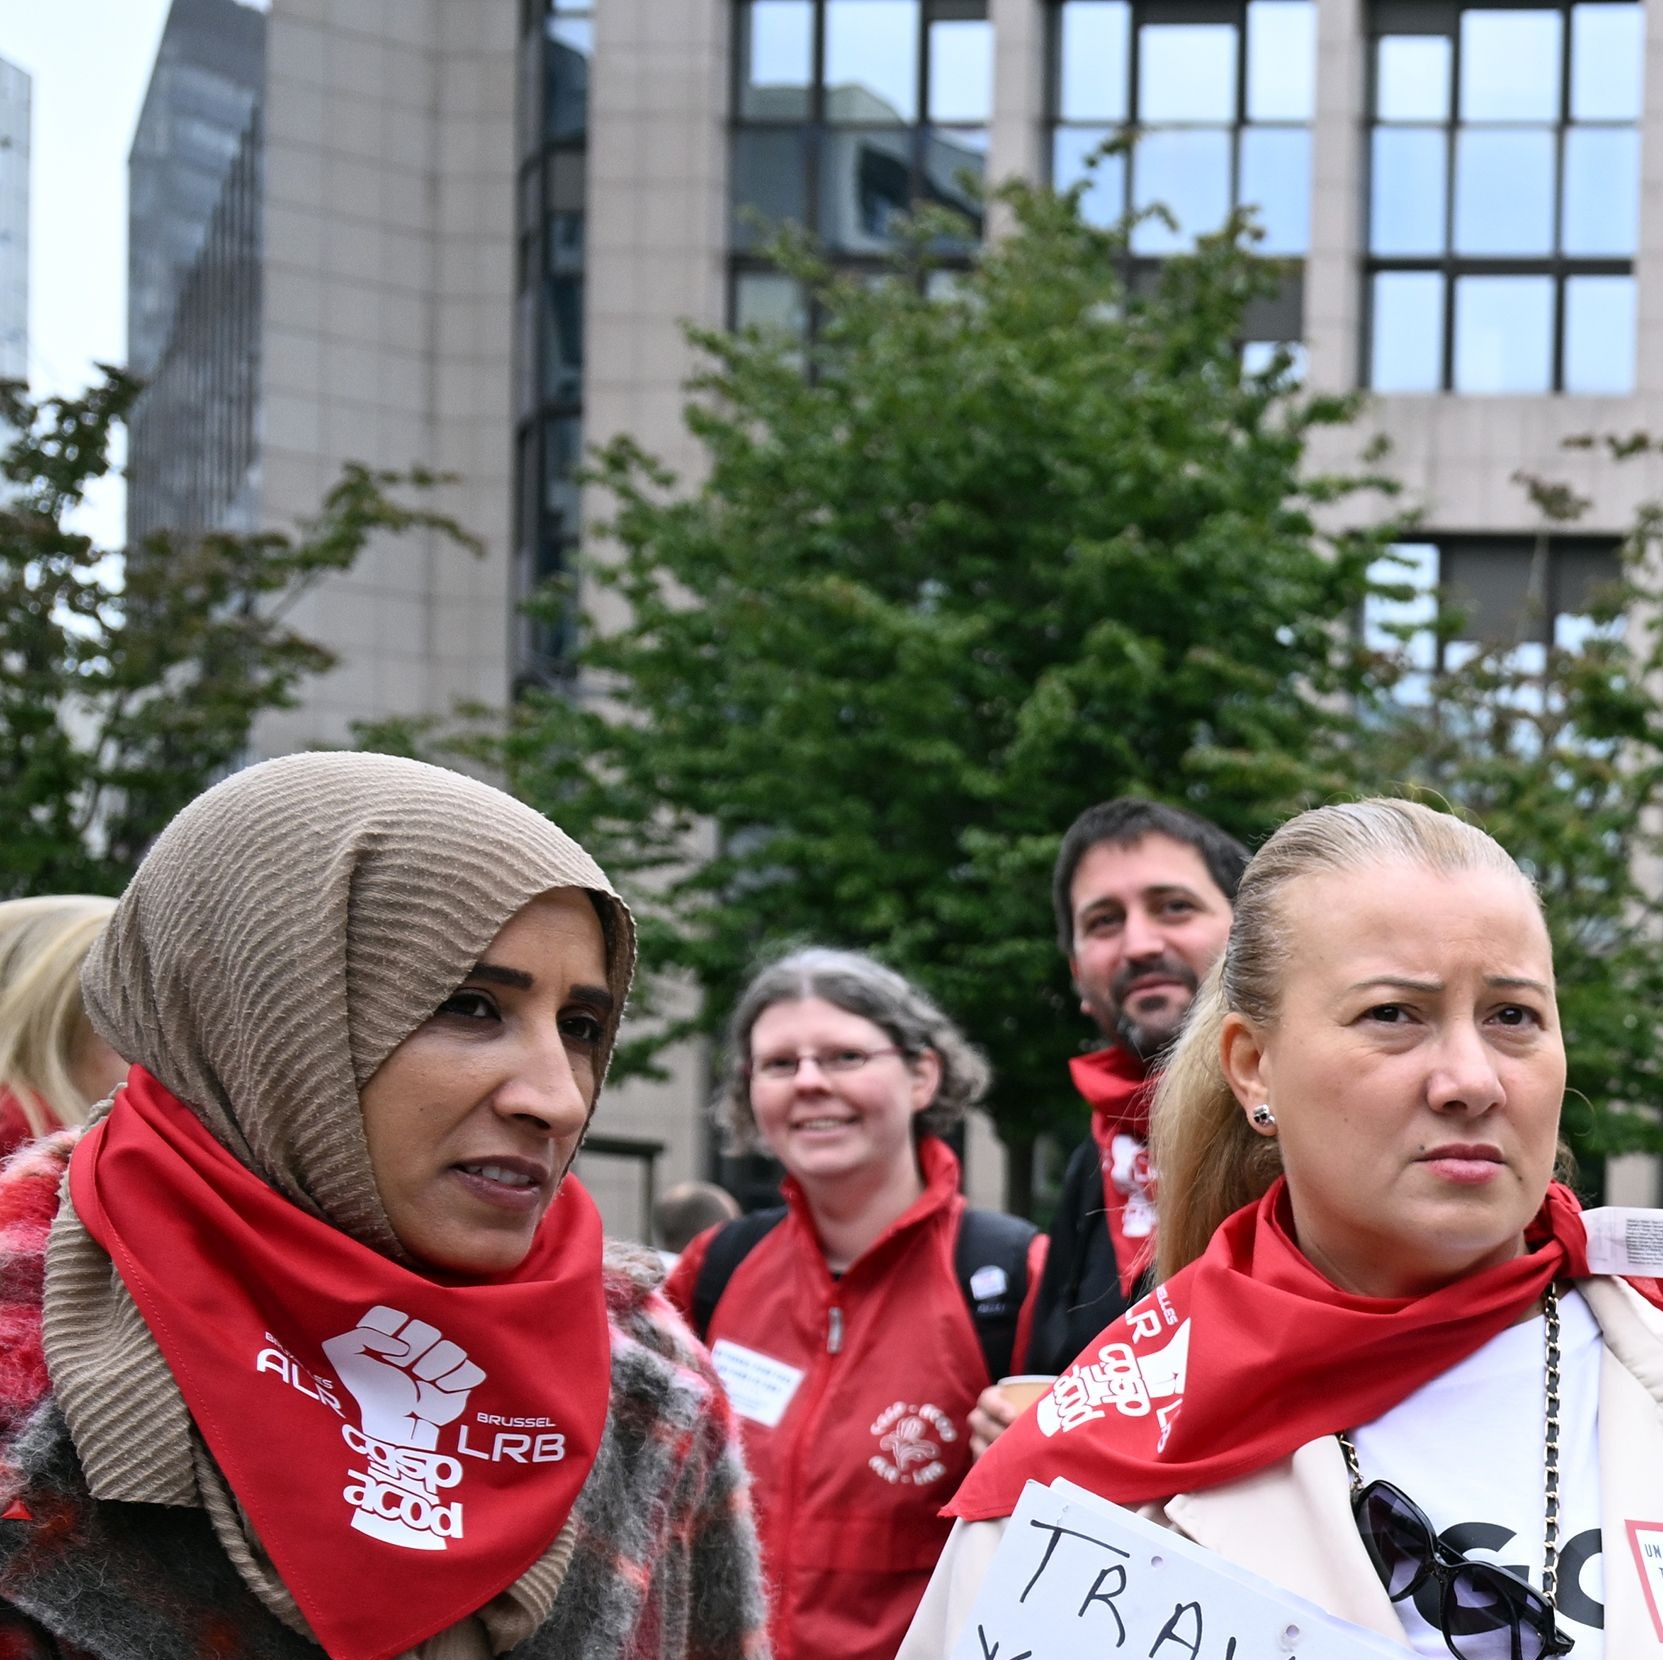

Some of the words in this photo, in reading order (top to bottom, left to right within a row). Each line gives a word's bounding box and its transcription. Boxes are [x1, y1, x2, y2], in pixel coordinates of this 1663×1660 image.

[256, 1348, 347, 1419] ALR
[456, 1425, 566, 1463] LRB
[476, 1412, 556, 1428] BRUSSEL
[341, 1423, 464, 1495] cgsp
[342, 1468, 464, 1539] acod
[1644, 1544, 1662, 1558] UN
